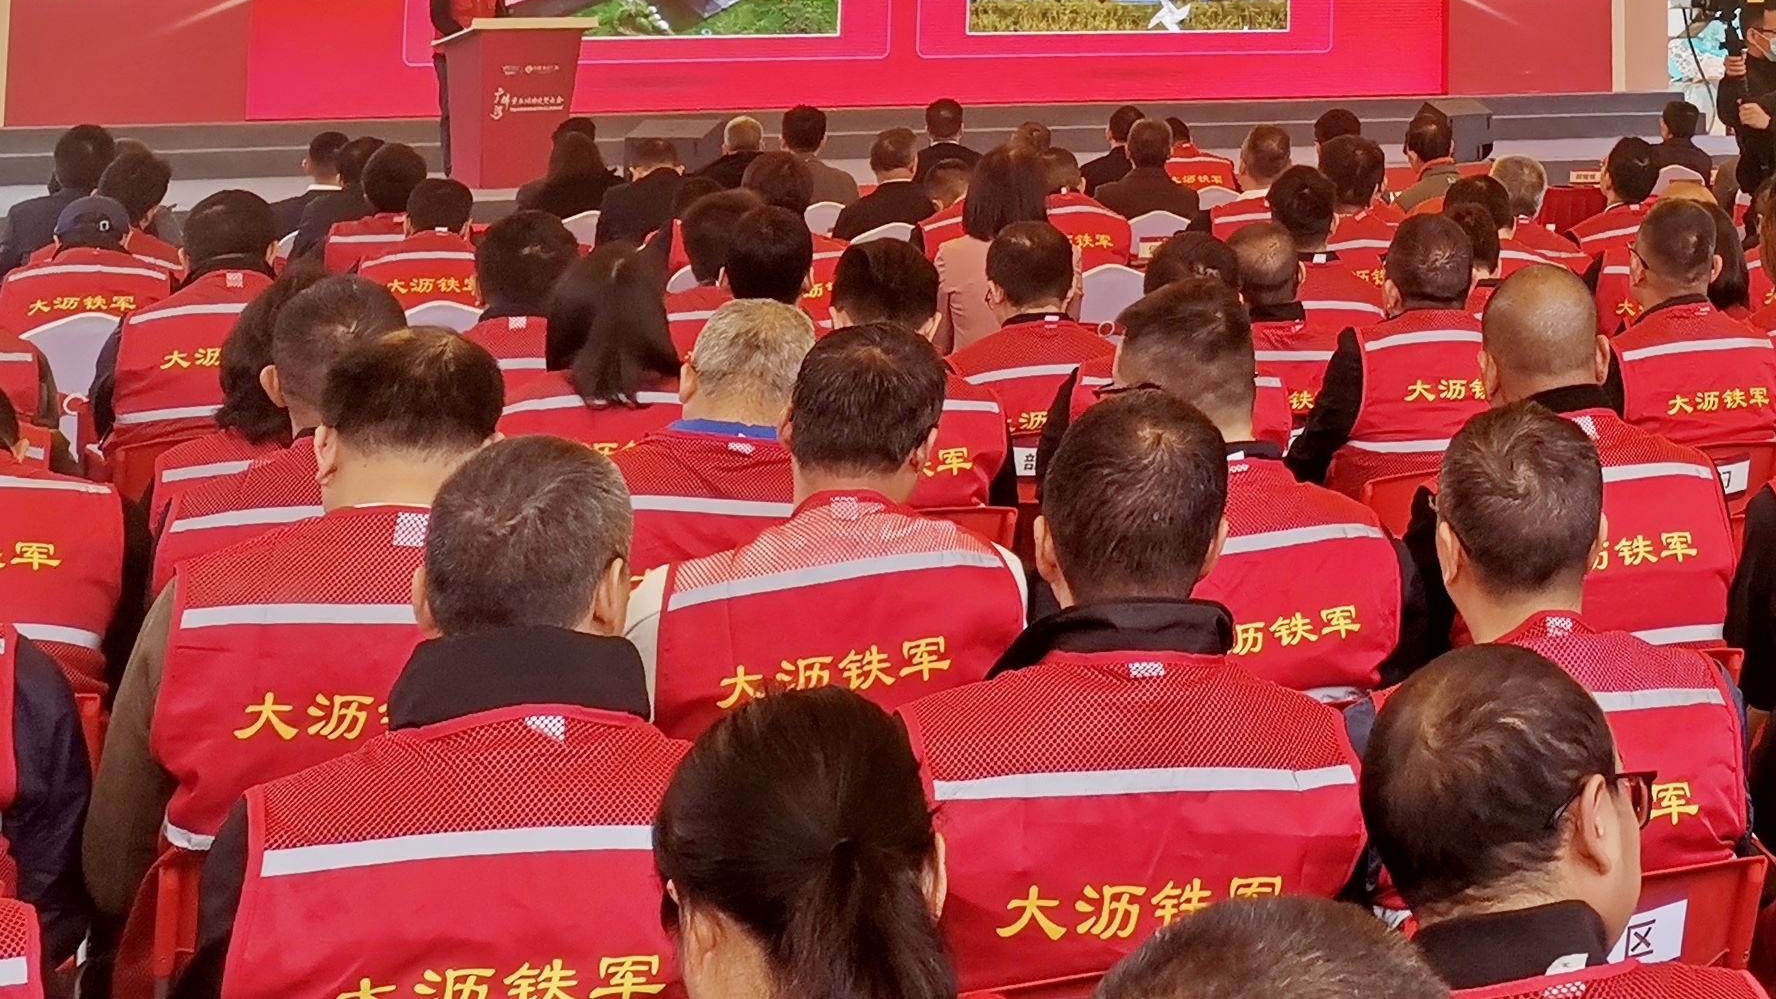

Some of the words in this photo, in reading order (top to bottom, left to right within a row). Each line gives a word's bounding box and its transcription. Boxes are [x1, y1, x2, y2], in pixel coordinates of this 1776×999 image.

[1068, 233, 1113, 249] 铁军
[28, 296, 136, 315] 大沥铁军
[1667, 387, 1770, 416] 大沥铁军
[923, 446, 973, 478] 军
[0, 541, 62, 571] 军
[716, 636, 951, 709] 大沥铁军
[233, 692, 390, 740] 大沥
